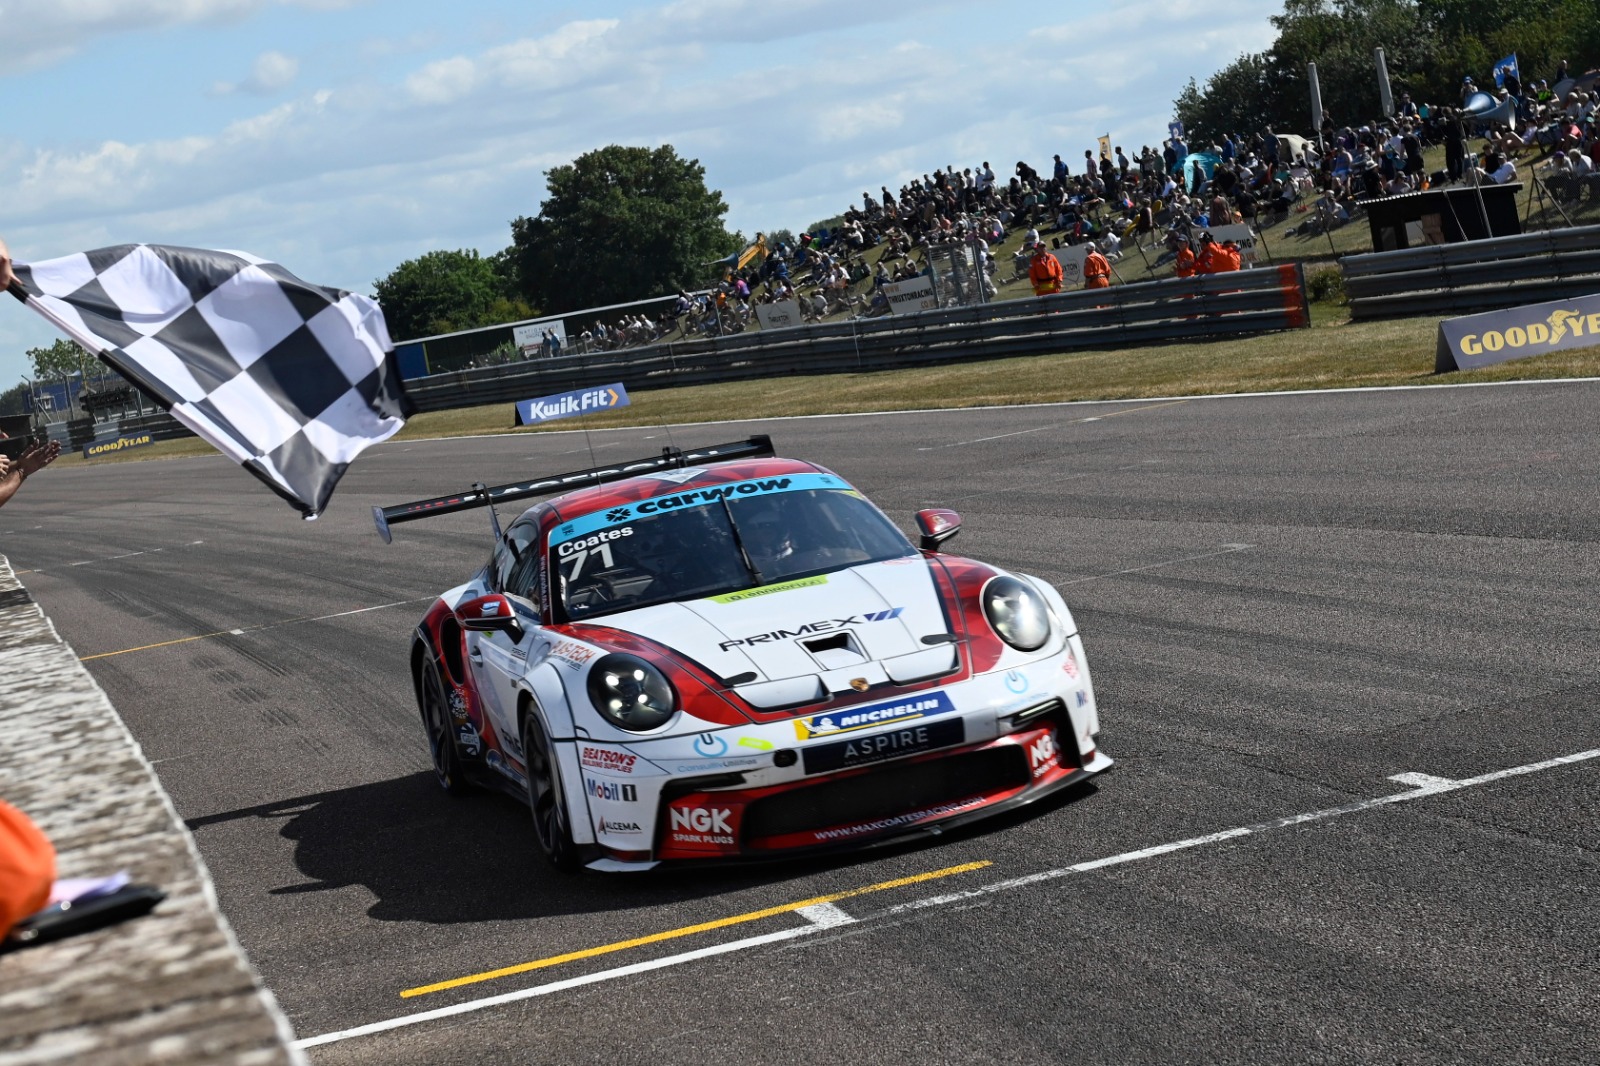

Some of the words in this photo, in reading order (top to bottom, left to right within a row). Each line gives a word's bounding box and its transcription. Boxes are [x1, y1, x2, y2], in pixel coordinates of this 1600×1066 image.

[519, 325, 559, 335] NATIONWDE
[1460, 313, 1600, 356] GOODYE
[88, 435, 150, 455] GOODYEAR
[636, 478, 792, 515] carwow
[558, 526, 634, 557] Coates
[560, 542, 615, 582] 71
[718, 615, 864, 652] PRIMEX
[840, 699, 939, 727] MICHELIN
[583, 747, 638, 767] BEATSON'S
[844, 727, 929, 759] ASPIRE
[604, 762, 633, 774] SUPPLIES
[587, 778, 619, 801] Mobil
[670, 806, 734, 834] NGK
[814, 796, 987, 840] WWW.MAXCOATESRACING.COM
[673, 833, 702, 843] SPARK
[703, 835, 734, 844] PLUGS
